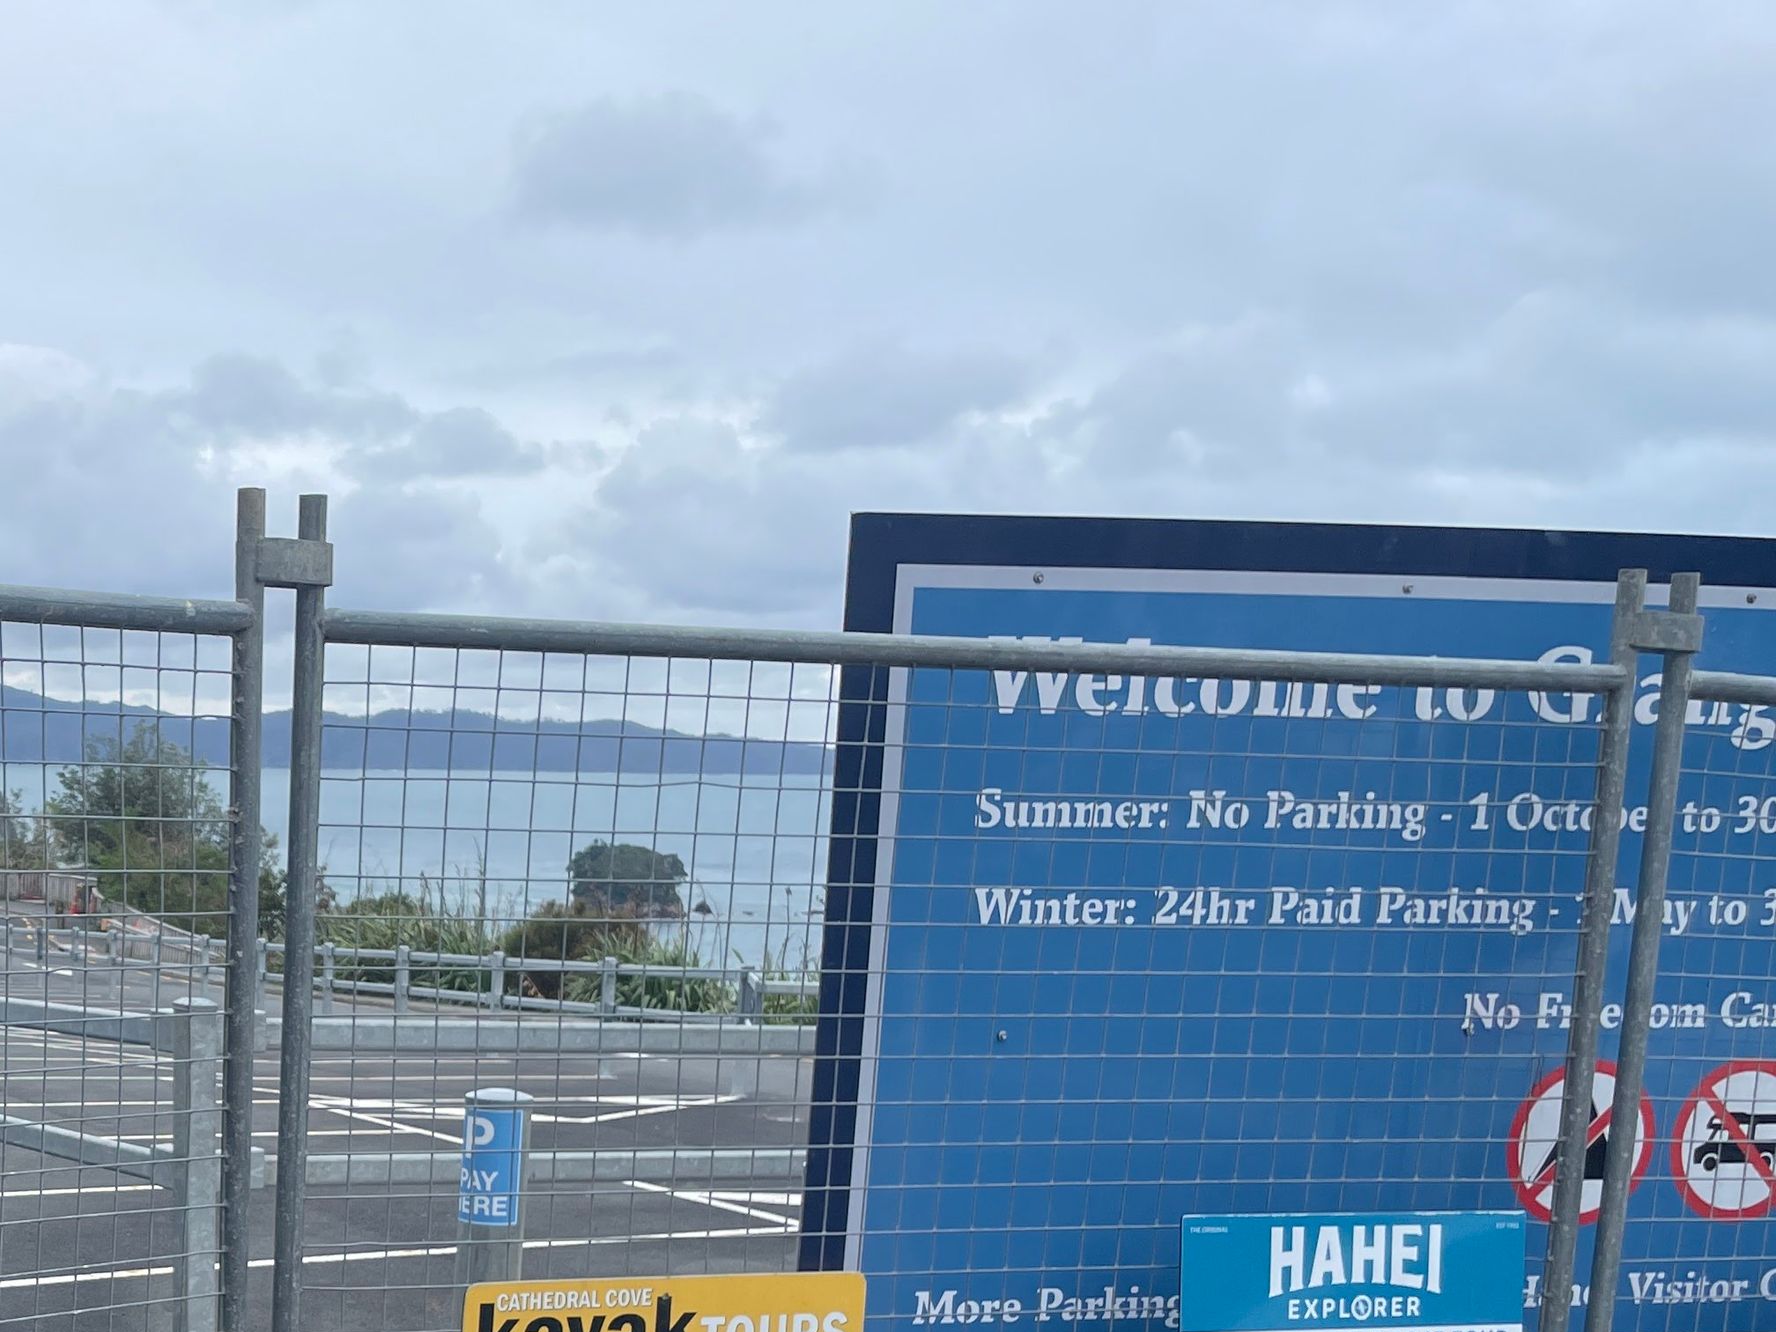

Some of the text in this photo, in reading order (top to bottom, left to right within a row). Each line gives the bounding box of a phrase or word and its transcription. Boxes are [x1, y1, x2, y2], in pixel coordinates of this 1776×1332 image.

[988, 635, 1381, 719] Welcome
[975, 788, 1168, 829] Summer:
[1186, 790, 1249, 829] No
[1264, 789, 1427, 841] Parking
[1469, 792, 1489, 831] 1
[1506, 793, 1648, 832] Octoe
[1683, 802, 1720, 833] to
[974, 887, 1136, 925] Winter:
[1153, 886, 1255, 924] 24hr
[1268, 886, 1362, 924] Paid
[1376, 886, 1536, 935] Parking
[1708, 895, 1746, 926] to
[1461, 992, 1520, 1029] No
[1537, 992, 1705, 1029] Freom
[465, 1116, 494, 1158] P
[460, 1168, 498, 1191] PAY
[1269, 1224, 1443, 1298] HAHEI
[497, 1288, 653, 1312] CATHEDRAL COVE
[912, 1285, 1179, 1328] More Parking
[1288, 1295, 1420, 1321] EXPLORER
[1628, 1270, 1749, 1305] Visitor
